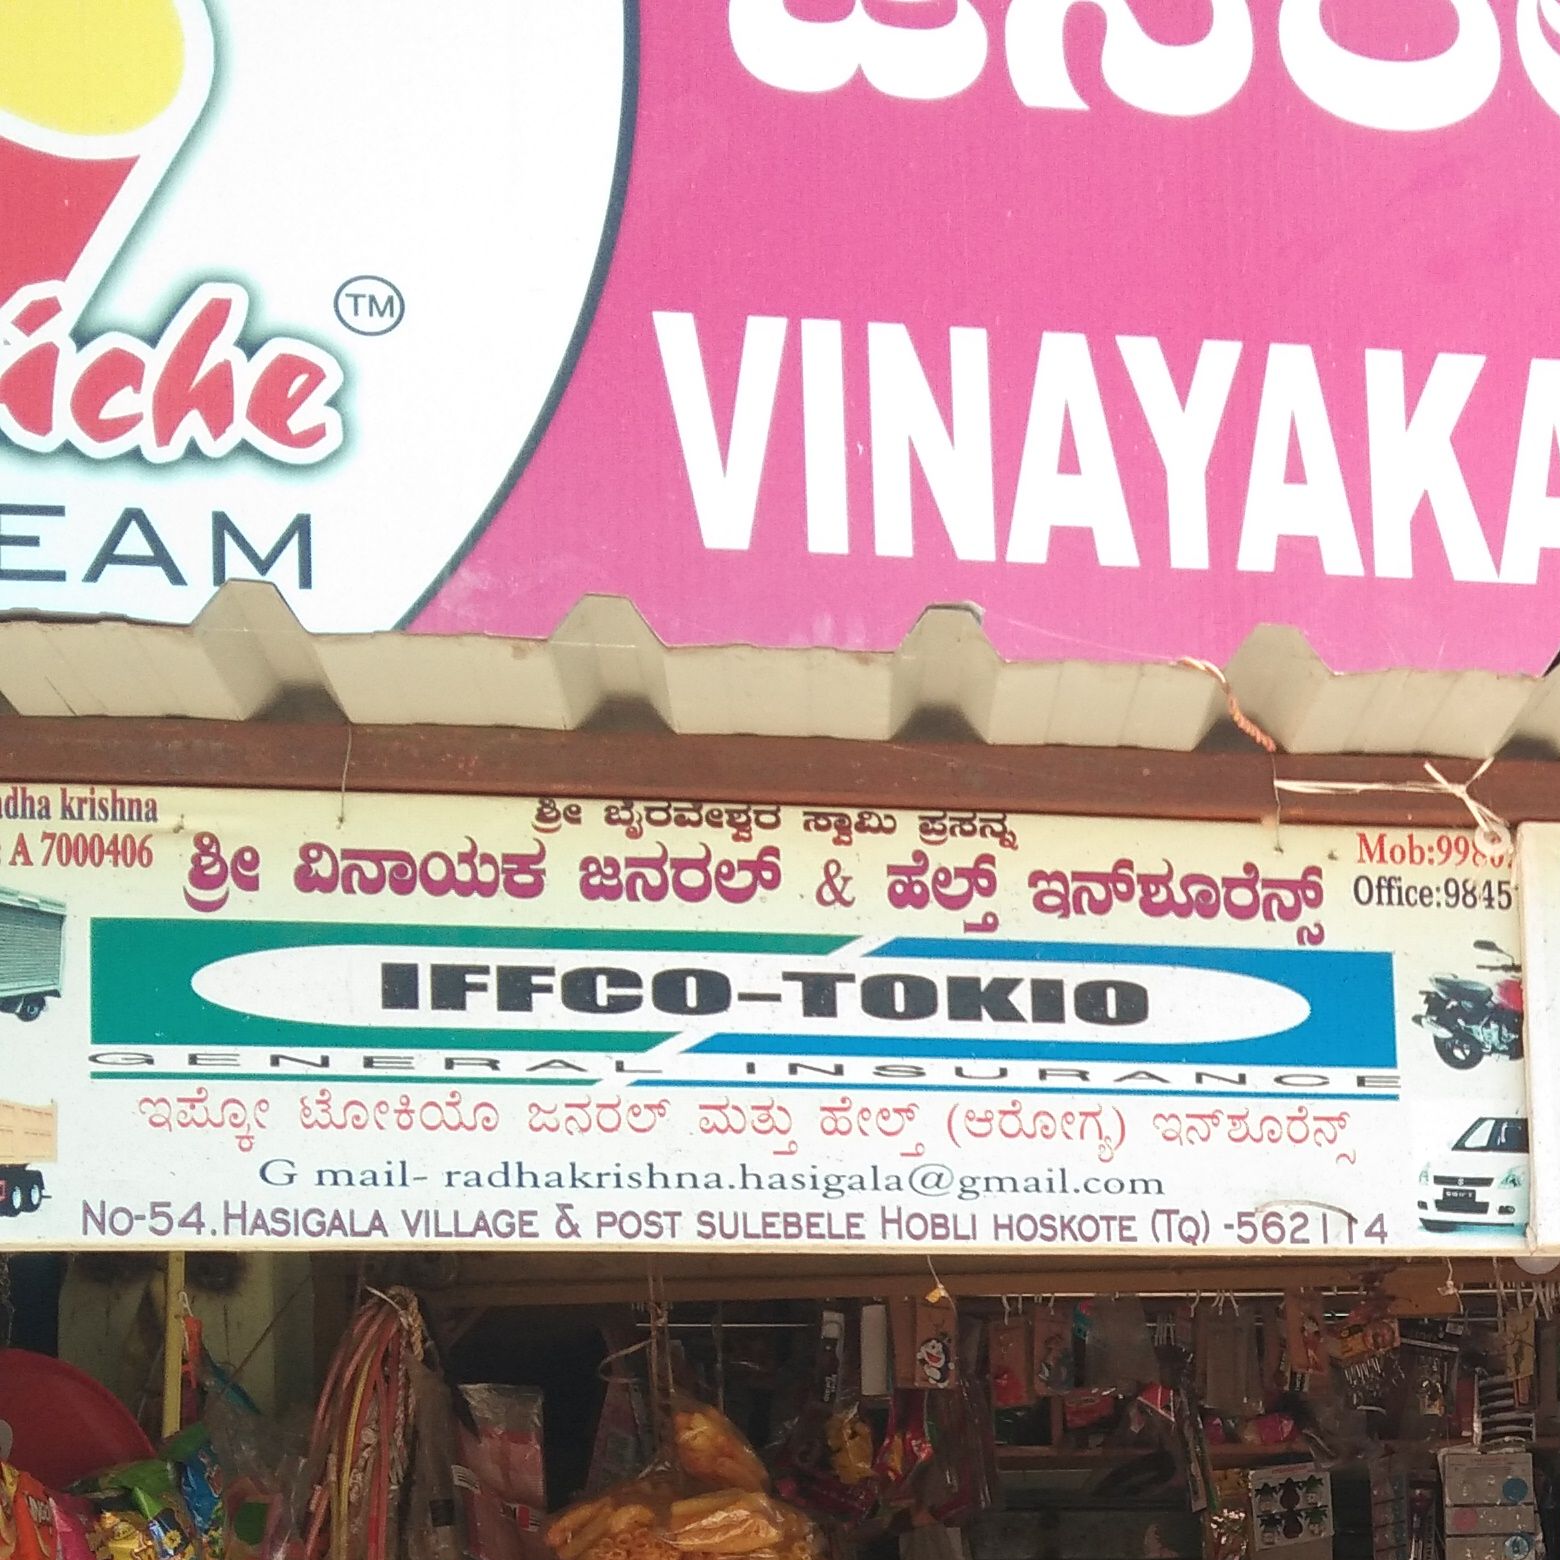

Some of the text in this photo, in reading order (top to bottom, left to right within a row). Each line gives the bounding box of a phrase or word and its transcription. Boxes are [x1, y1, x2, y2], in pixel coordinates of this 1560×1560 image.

[60, 787, 159, 823] krishna
[9, 831, 154, 868] A 7000406
[183, 832, 260, 913] ಶ್ರೀ
[815, 858, 857, 908] &
[381, 962, 1149, 1027] IFFCO-TOKIO
[88, 1051, 1402, 1088] GENERAL INSURANCE
[443, 1160, 1165, 1200] radhakrishna.hasigala@gmail.com
[554, 1202, 582, 1239] &
